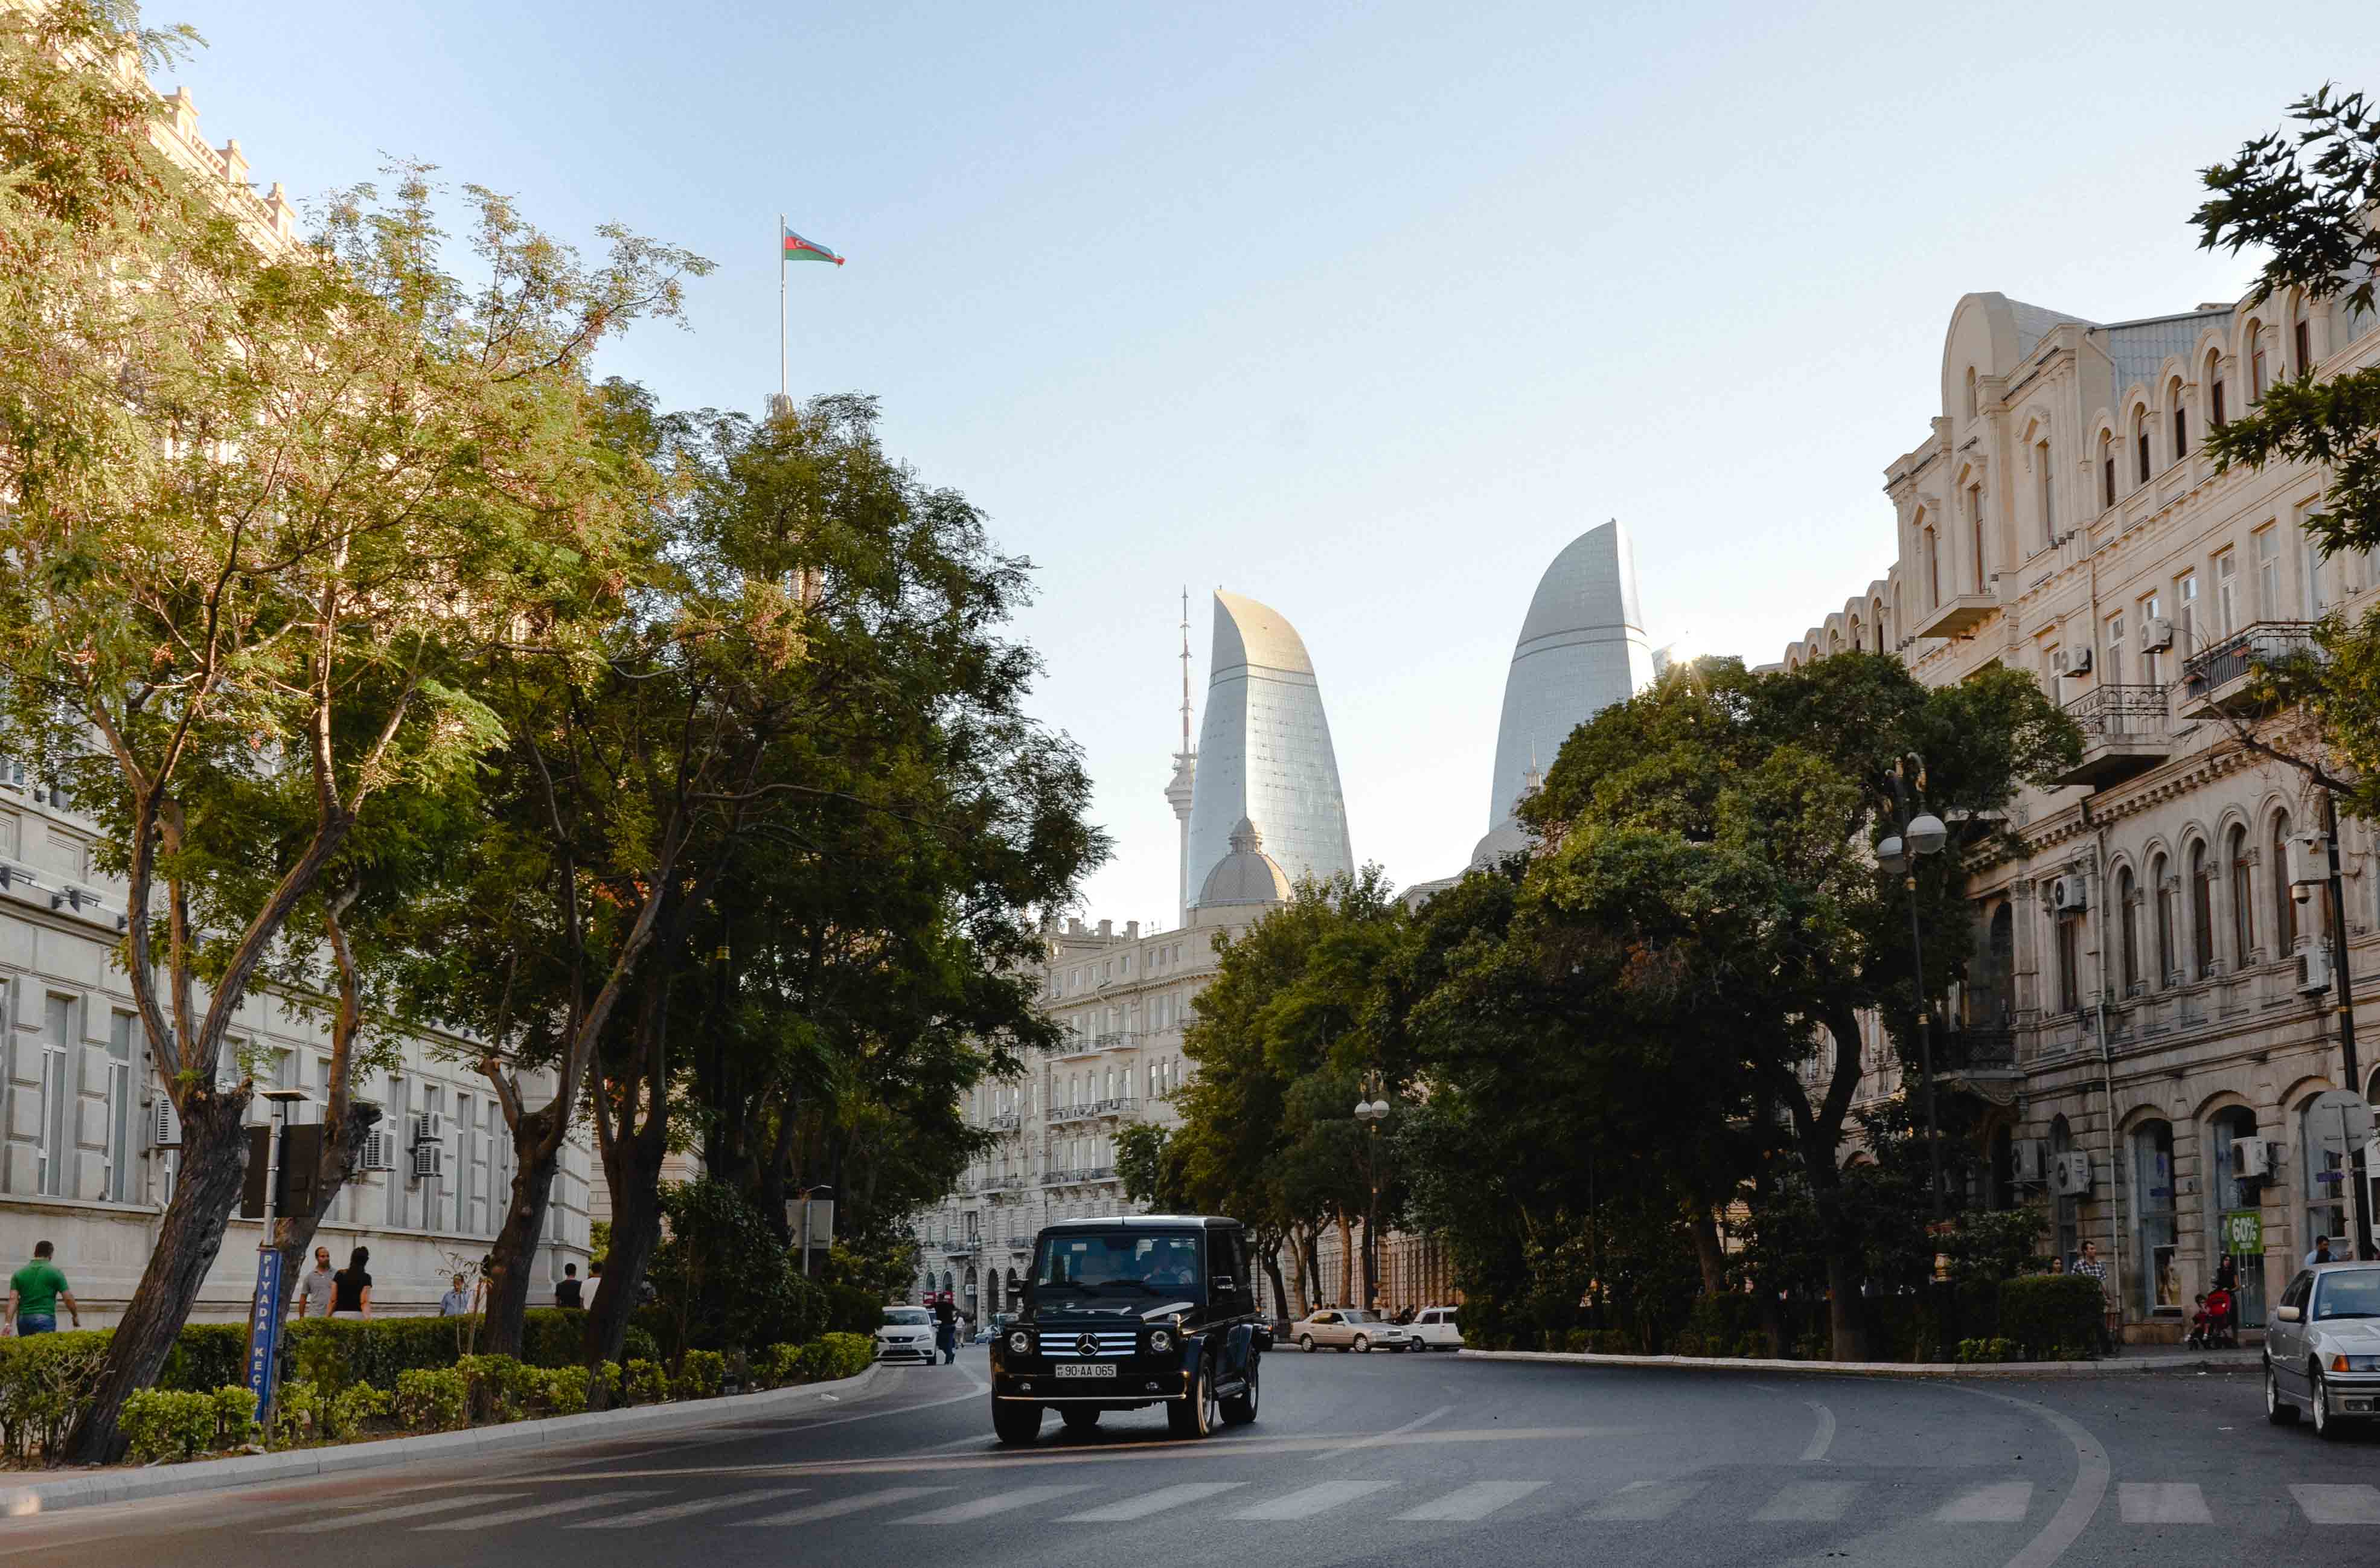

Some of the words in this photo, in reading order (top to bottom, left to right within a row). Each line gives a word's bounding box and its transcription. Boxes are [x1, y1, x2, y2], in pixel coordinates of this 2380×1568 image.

[257, 1255, 272, 1331] PİYADA
[251, 1347, 264, 1419] KEÇİ
[1096, 1366, 1114, 1377] 065
